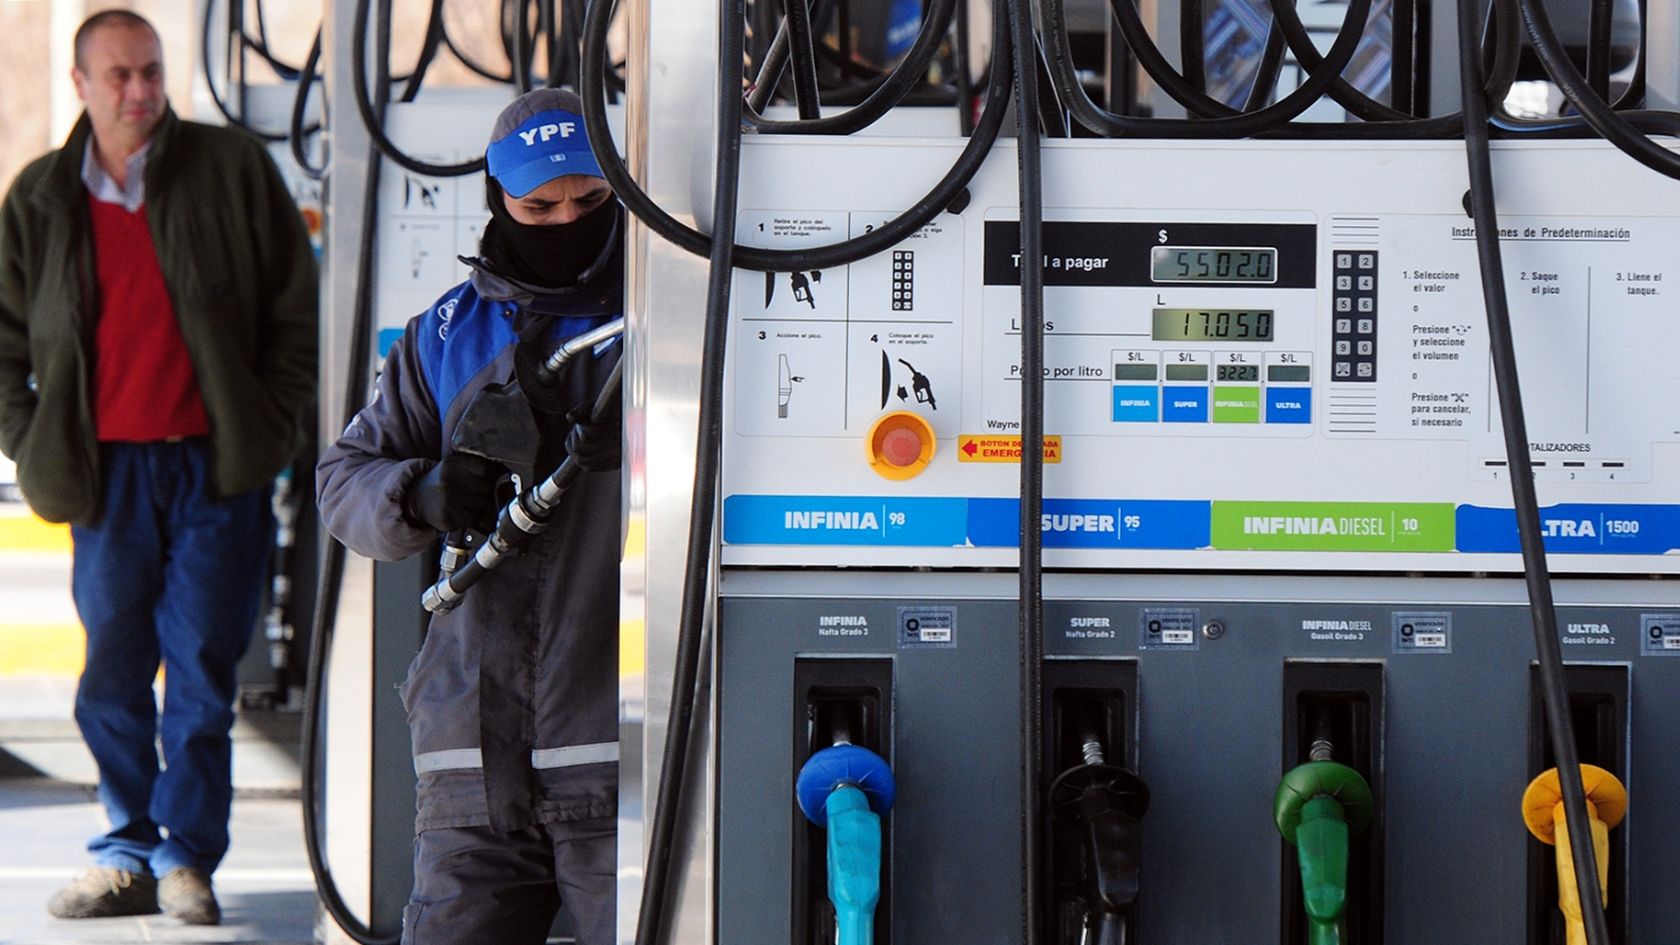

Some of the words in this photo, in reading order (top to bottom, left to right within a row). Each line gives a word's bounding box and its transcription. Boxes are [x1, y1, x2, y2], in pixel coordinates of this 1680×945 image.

[518, 122, 575, 146] YPF
[758, 223, 764, 232] 1
[866, 225, 873, 234] 2
[1158, 229, 1168, 244] $
[1524, 228, 1536, 237] de
[1542, 227, 1630, 238] Predeterminación
[1052, 258, 1060, 268] a
[1065, 258, 1109, 271] pagar
[1177, 252, 1271, 278] 5502.0
[1403, 271, 1411, 279] 1.
[1414, 270, 1460, 279] Seleccione
[1520, 272, 1529, 280] 2.
[1532, 272, 1558, 282] Saque
[1616, 273, 1624, 281] 3.
[1627, 273, 1650, 281] Llene
[1654, 273, 1662, 281] el
[1414, 284, 1421, 292] el
[1424, 284, 1445, 292] valor
[1532, 286, 1539, 294] el
[1542, 286, 1560, 295] pico
[1627, 287, 1660, 296] tanque.
[1157, 294, 1166, 305] L
[1184, 312, 1270, 338] 17.050
[1363, 322, 1368, 330] 8
[1412, 325, 1449, 334] Presione
[758, 331, 766, 340] 3
[870, 334, 878, 342] 4
[1413, 339, 1419, 347] y
[1421, 338, 1465, 346] seleccione
[1128, 352, 1144, 362] $/L
[1179, 353, 1195, 362] $/L
[1230, 353, 1246, 362] $/L
[1281, 353, 1297, 363] $/L
[1412, 352, 1421, 360] el
[1054, 367, 1075, 378] por
[1078, 366, 1103, 376] litro
[1220, 366, 1257, 379] 322.7
[1412, 392, 1448, 401] Presione
[1412, 406, 1430, 414] para
[1433, 405, 1471, 414] cancelar,
[987, 420, 1020, 430] Wayne
[1412, 417, 1419, 426] si
[1421, 418, 1463, 426] necesario
[1528, 443, 1591, 452] TALIZADORES
[983, 449, 1056, 458] EMERGIA
[785, 511, 878, 529] INFINIA
[889, 512, 906, 525] 98
[1042, 514, 1115, 532] SUPER
[1124, 516, 1140, 528] 95
[1244, 517, 1338, 534] INFINIA
[1340, 518, 1385, 536] DIESEL
[1402, 518, 1418, 531] 10
[1606, 520, 1640, 534] 1500
[820, 616, 867, 626] INFINIA
[1070, 618, 1110, 627] SUPER
[1567, 624, 1610, 634] ULTRA
